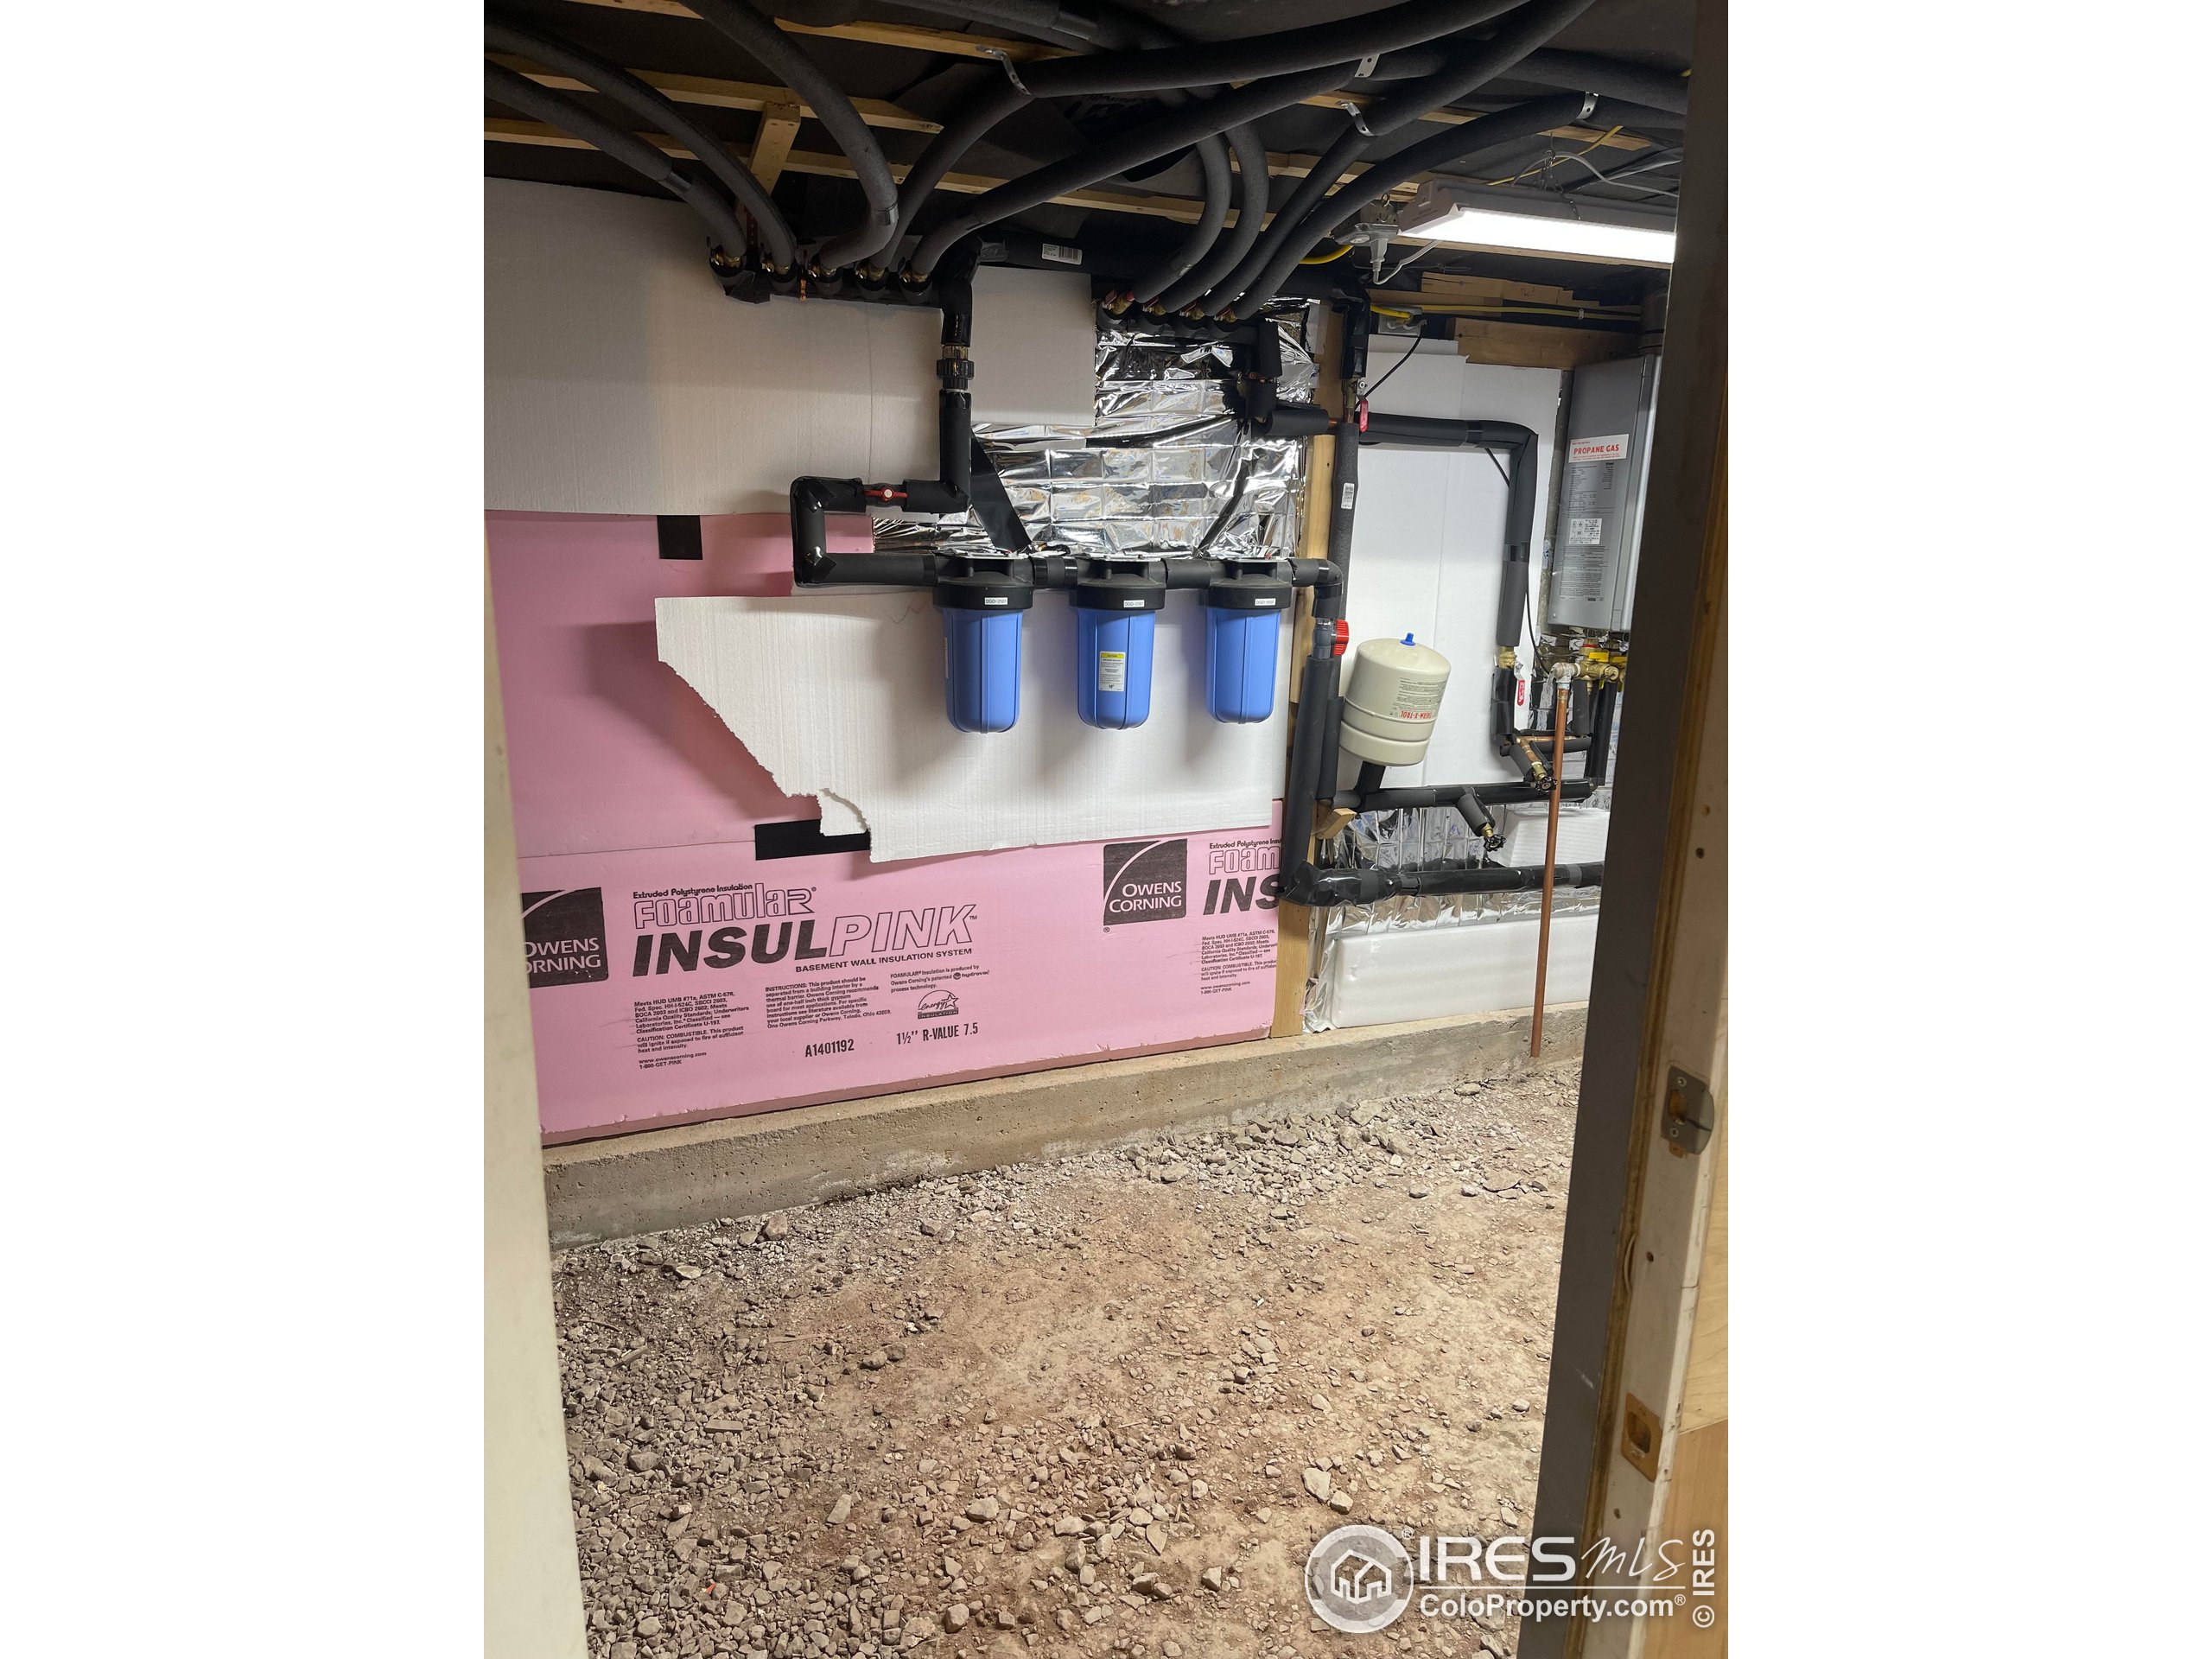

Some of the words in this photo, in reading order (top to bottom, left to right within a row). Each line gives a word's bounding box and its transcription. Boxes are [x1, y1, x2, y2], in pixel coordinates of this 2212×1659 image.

[1573, 445, 1605, 455] PROPANE
[1606, 444, 1619, 452] GAS
[1237, 840, 1269, 848] Polystyrene
[633, 889, 668, 899] Extruded
[671, 886, 715, 897] Polystyrene
[717, 883, 753, 893] Insulation
[1122, 881, 1182, 897] OWENS
[1109, 895, 1182, 913] CORNING
[526, 954, 601, 974] RNING
[795, 961, 847, 973] BASEMENT
[851, 958, 877, 966] WALL
[879, 951, 932, 964] INSULATION
[935, 948, 972, 957] SYSTEM
[765, 983, 807, 992] INSTRUCTIONS:
[636, 1025, 673, 1034] Classification
[922, 1025, 960, 1042] R-VALUE
[963, 1022, 978, 1036] 7.5
[805, 1039, 855, 1058] A1401192
[639, 1053, 706, 1064] www.owenscorning.com
[640, 1060, 682, 1069] 1-800-GET-PINK
